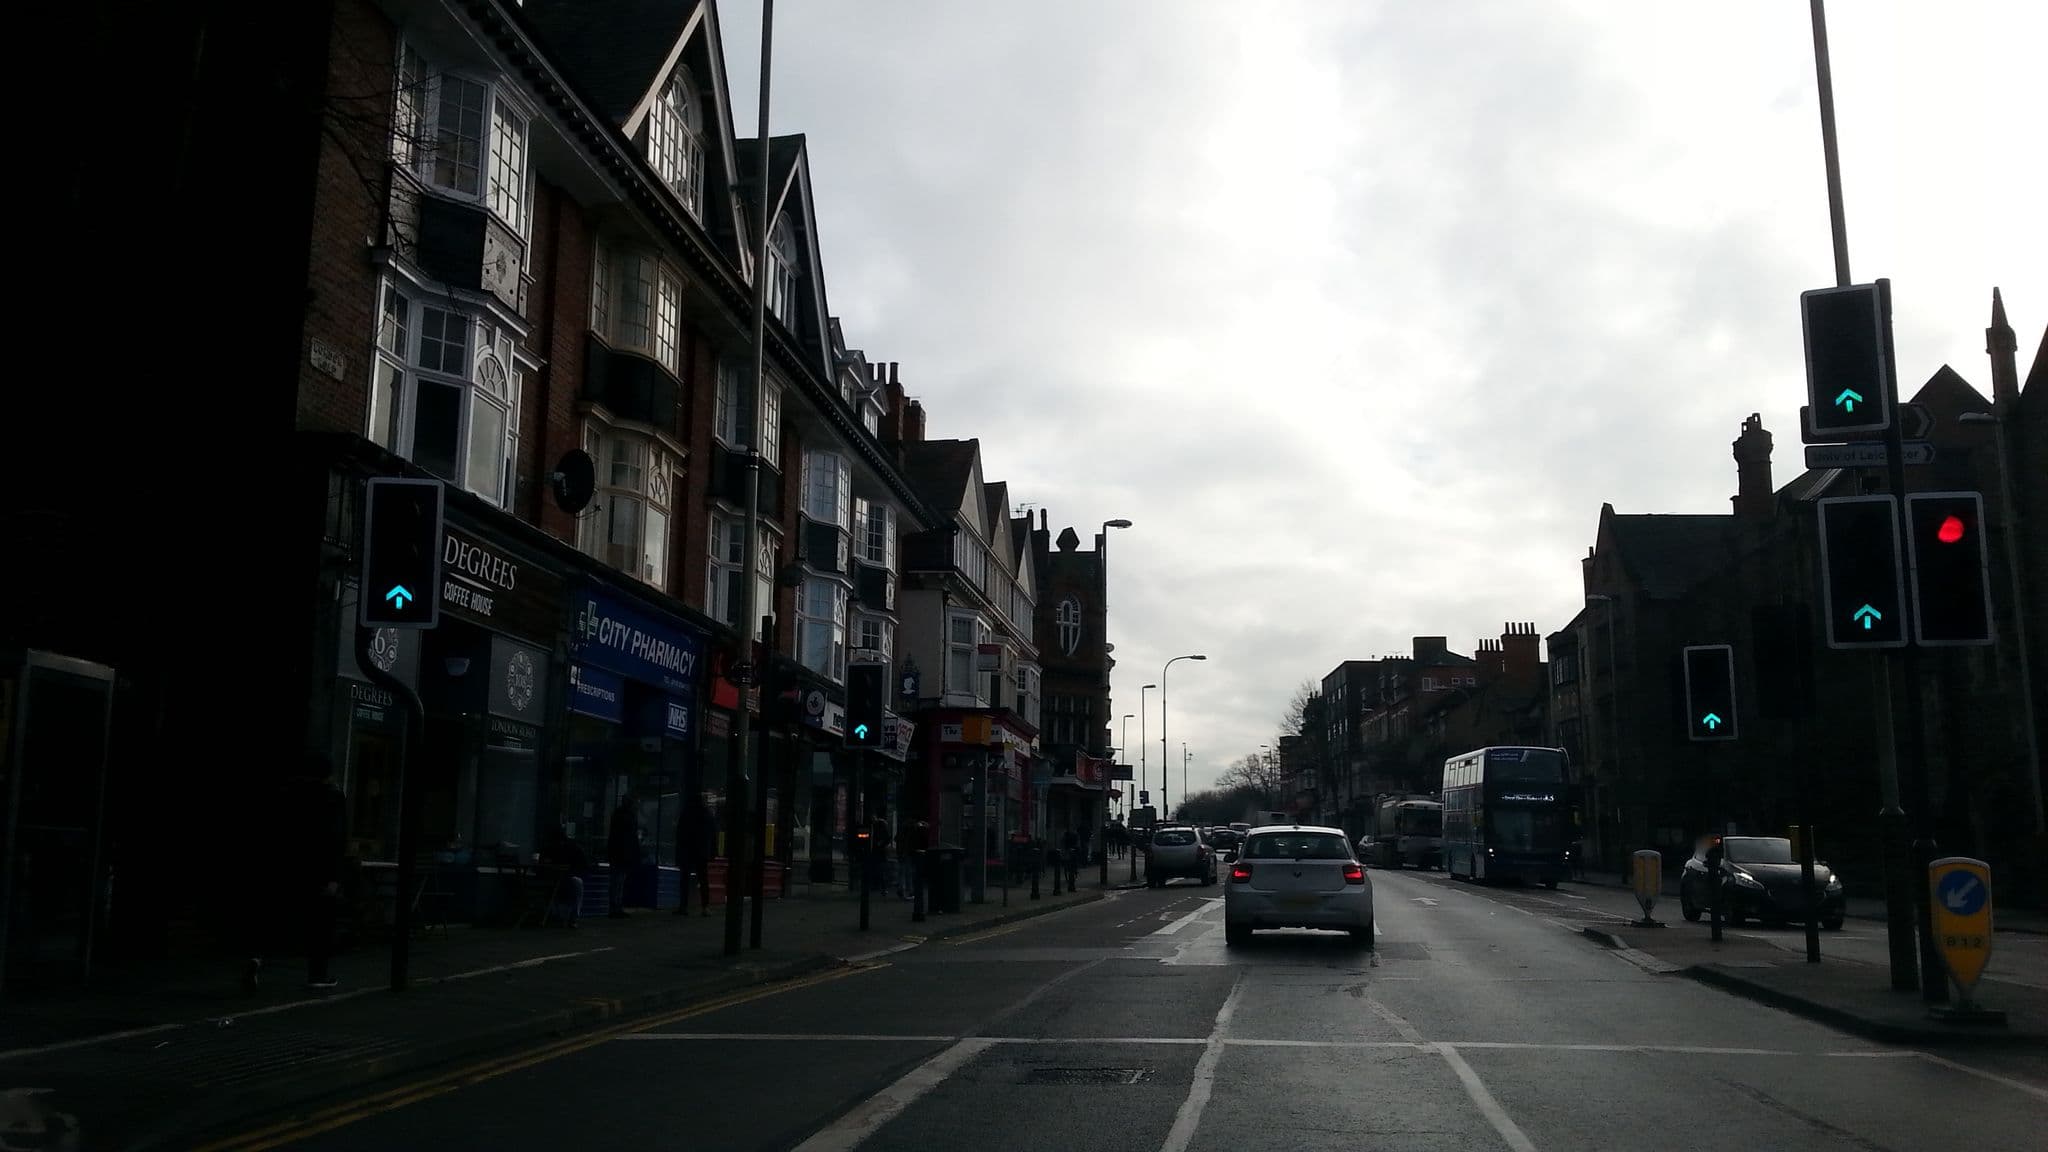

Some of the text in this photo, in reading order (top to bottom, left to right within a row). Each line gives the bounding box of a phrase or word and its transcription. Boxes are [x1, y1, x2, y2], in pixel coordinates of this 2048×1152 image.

[443, 535, 517, 591] DEGREES
[444, 581, 494, 617] COFFEE HOUSE
[599, 617, 696, 677] CITY PHARMACY
[351, 684, 392, 706] DEGREES
[668, 704, 687, 730] NHS
